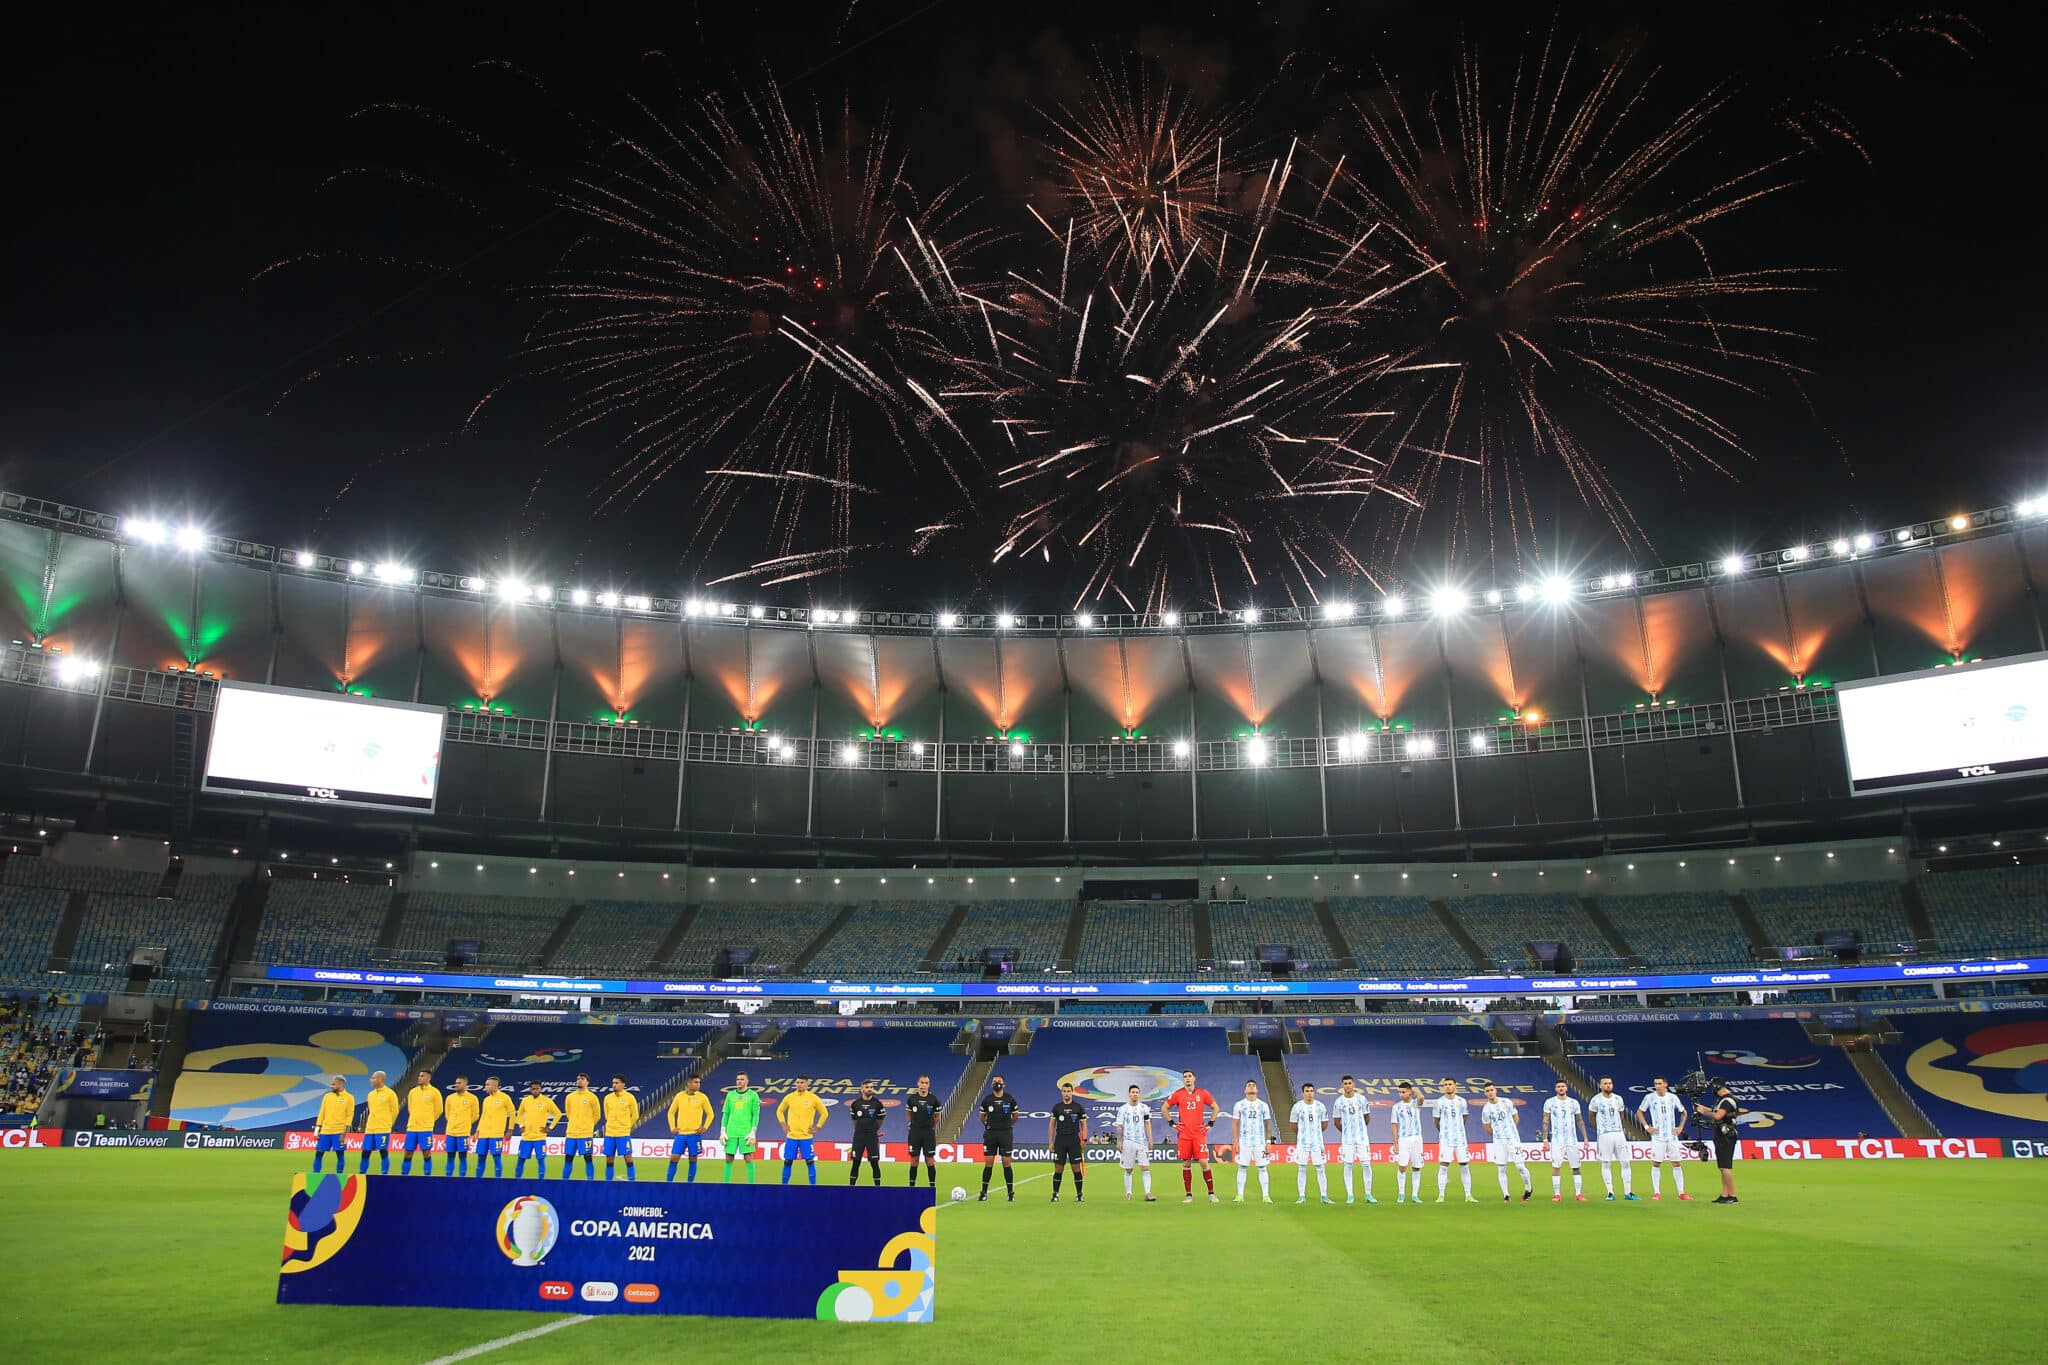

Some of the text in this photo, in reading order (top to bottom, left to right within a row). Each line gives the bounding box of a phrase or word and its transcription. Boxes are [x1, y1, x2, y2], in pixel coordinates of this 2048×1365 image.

[1957, 765, 1996, 778] TCL
[306, 787, 339, 799] TCL
[212, 1002, 261, 1012] CONMEBOL
[262, 1004, 286, 1013] COPA
[288, 1005, 328, 1015] AMERICA
[1992, 1001, 2047, 1011] CONMEBOL
[629, 1017, 670, 1026] CONMEBOL
[671, 1018, 693, 1027] COPA
[695, 1018, 729, 1026] AMERICA
[1570, 1014, 1614, 1024] CONMEBOL
[1616, 1014, 1639, 1023] COPA
[1641, 1013, 1679, 1022] AMERICA
[885, 1020, 904, 1028] VIBRA
[905, 1020, 912, 1028] EL
[1053, 1020, 1096, 1028] CONMEBOL
[1097, 1020, 1119, 1028] COPA
[1121, 1020, 1158, 1028] AMERICA
[1729, 1082, 1846, 1094] MERICA
[1186, 1101, 1197, 1110] 23
[1248, 1110, 1257, 1119] 22
[1348, 1107, 1356, 1115] 13
[1496, 1110, 1506, 1121] 20
[1132, 1115, 1140, 1123] 10
[93, 1133, 169, 1148] TeamViewer
[202, 1134, 276, 1149] TeamViewer
[381, 1135, 386, 1144] 7
[584, 1140, 592, 1149] 17
[1754, 1140, 1822, 1160] TCL
[1836, 1139, 1904, 1159] TCL
[1918, 1138, 1988, 1159] TCL
[570, 1219, 714, 1240] COPA AMERICA
[628, 1246, 656, 1262] 2021
[545, 1285, 569, 1295] TCL
[596, 1287, 614, 1297] Kwai
[627, 1288, 656, 1297] betsson
